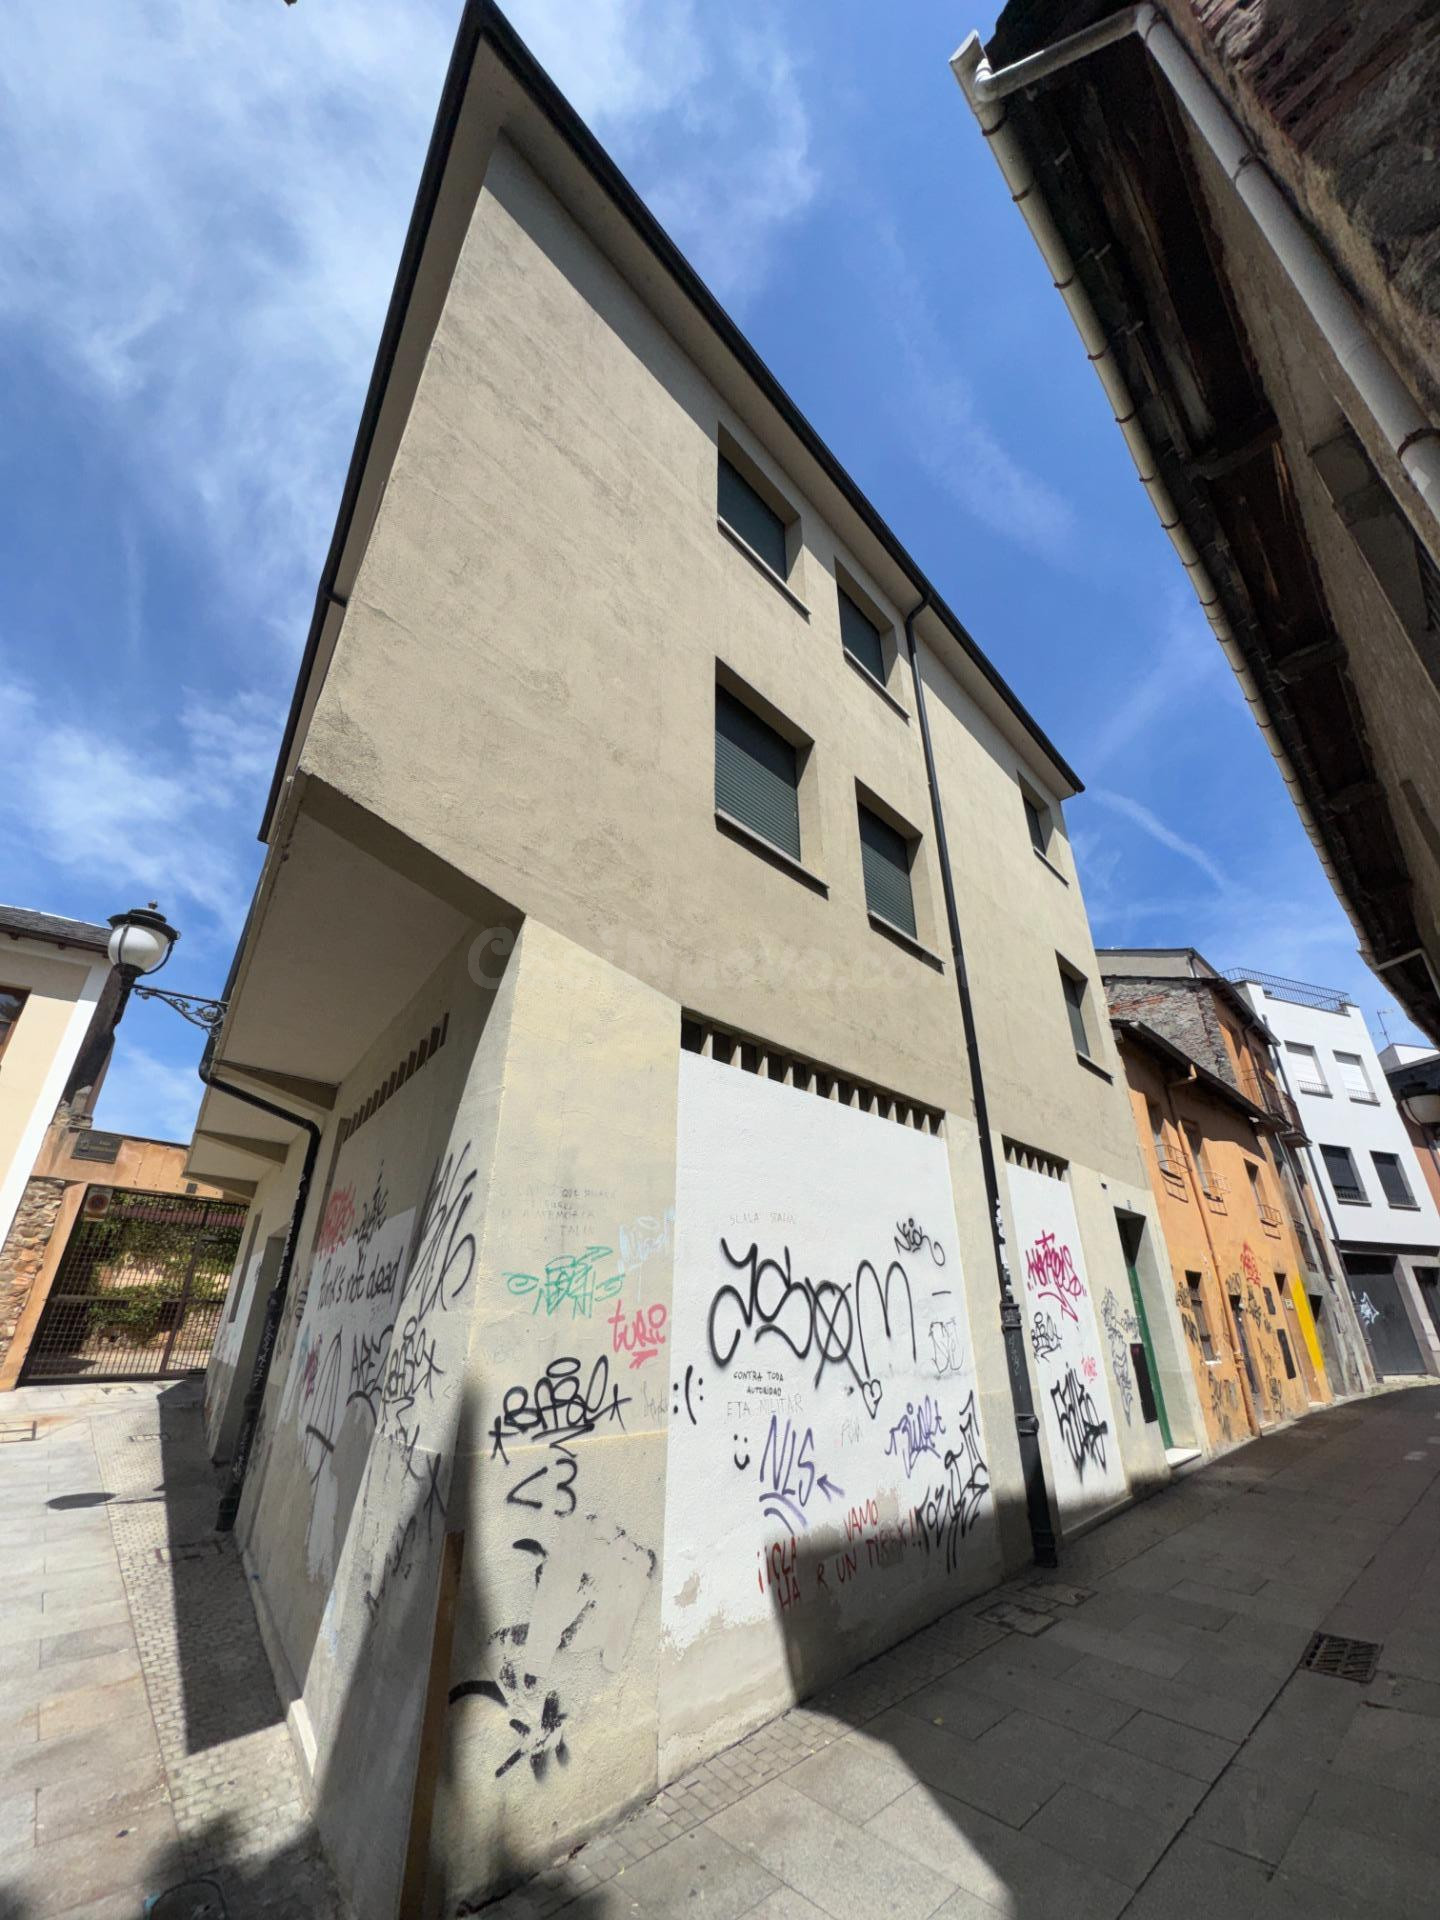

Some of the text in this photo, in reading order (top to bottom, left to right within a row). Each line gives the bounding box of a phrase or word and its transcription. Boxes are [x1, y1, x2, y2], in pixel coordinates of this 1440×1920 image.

[733, 1370, 785, 1383] CONTRA TODA
[746, 1385, 782, 1398] AUTORIDAD
